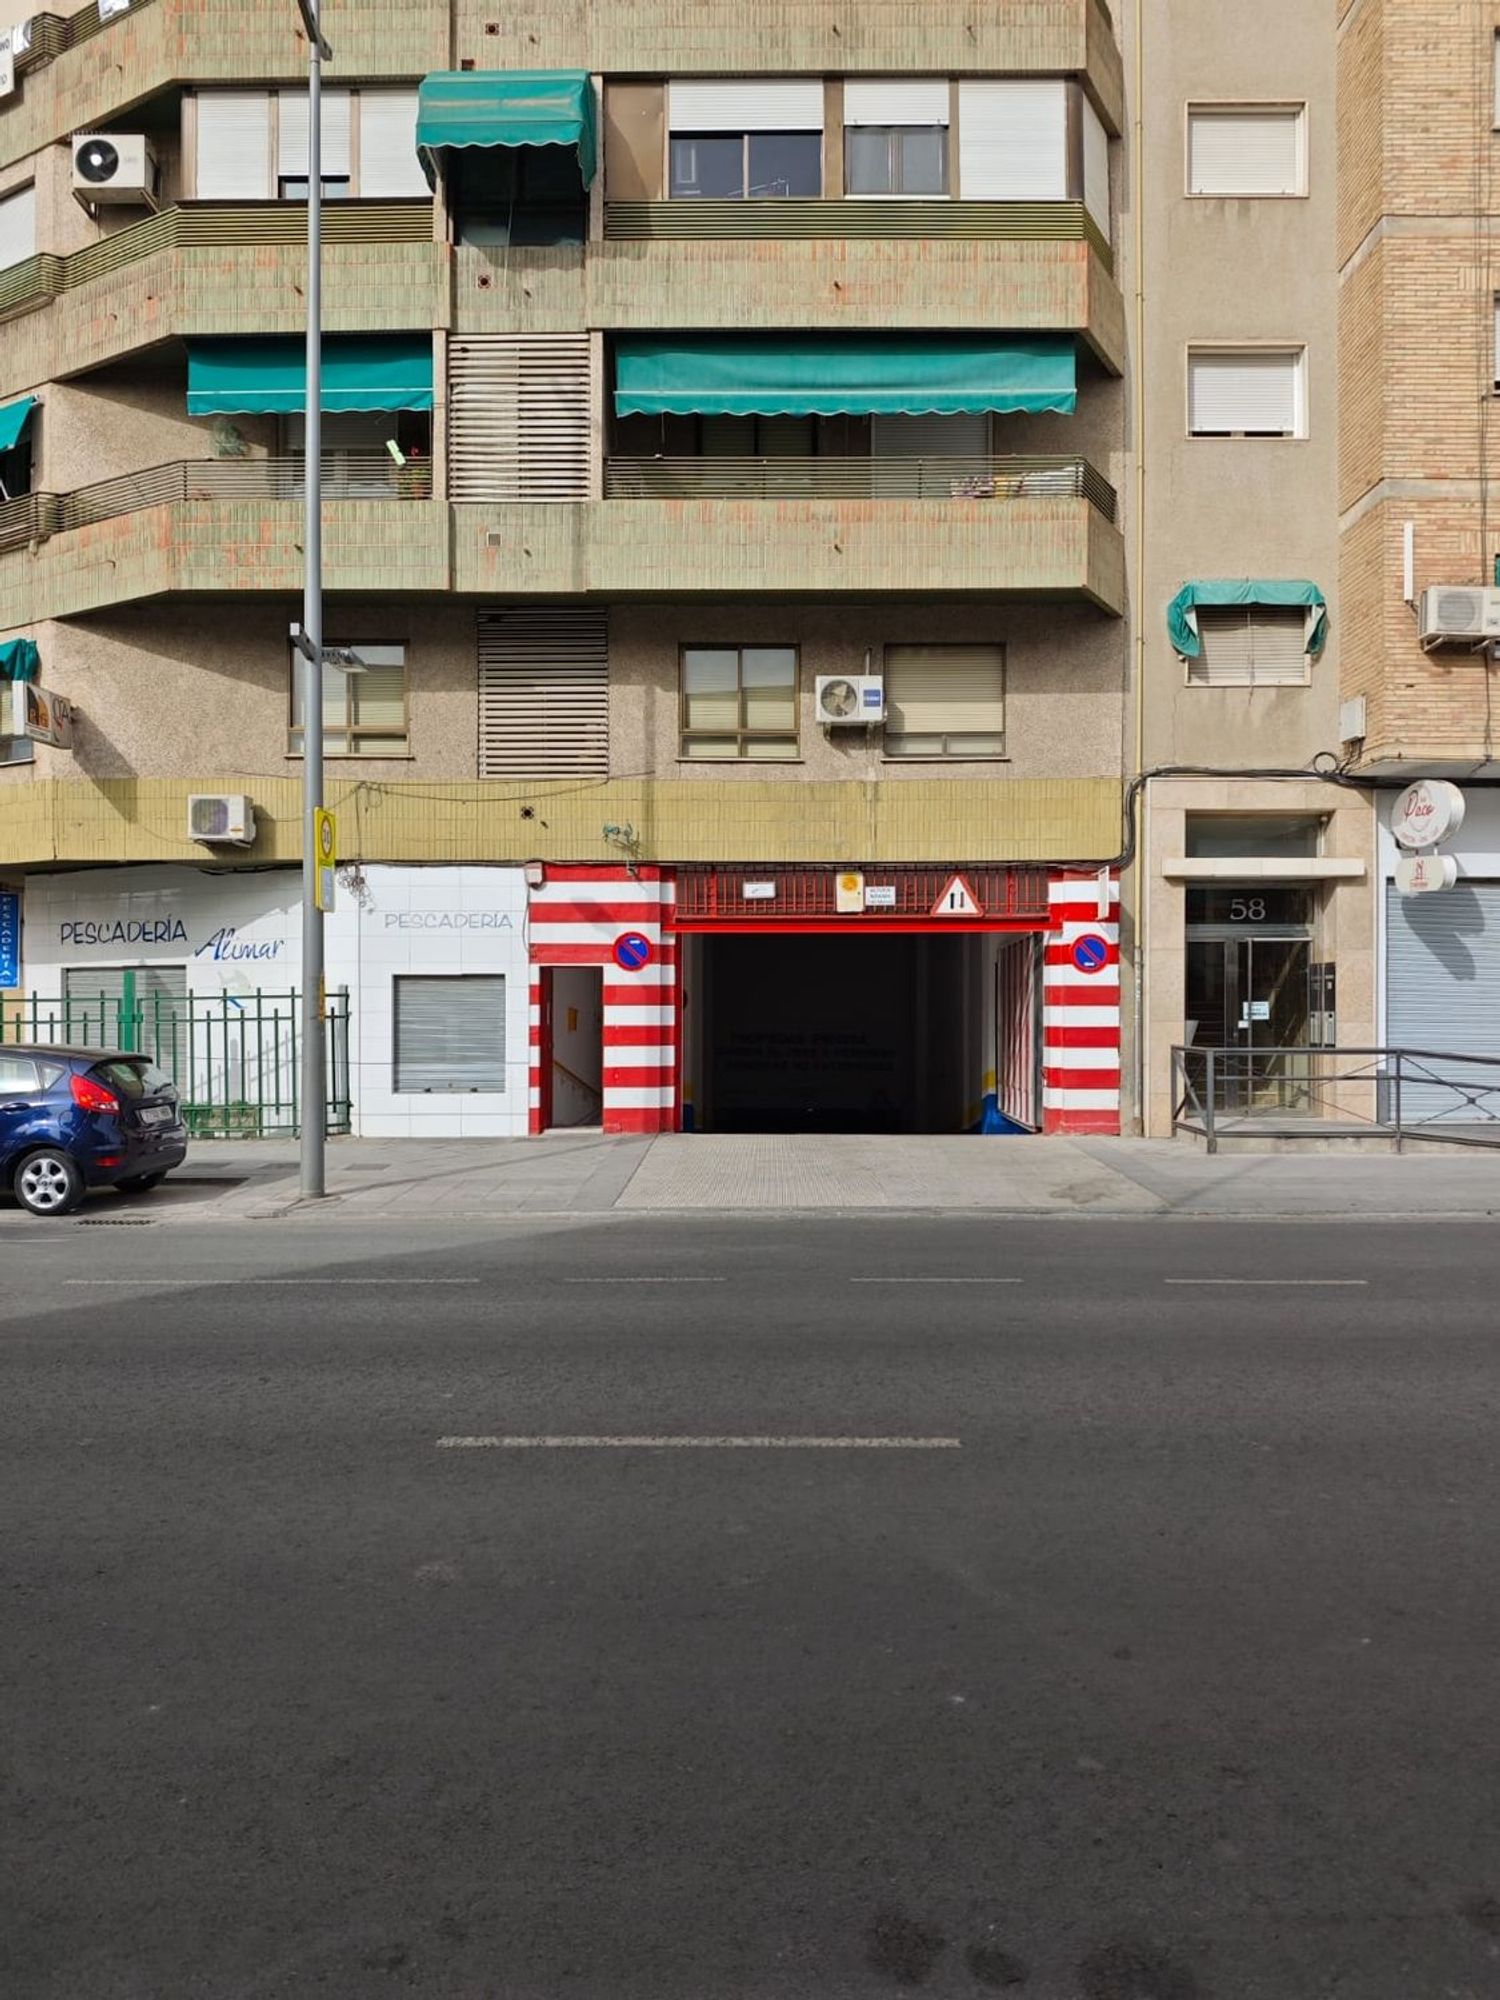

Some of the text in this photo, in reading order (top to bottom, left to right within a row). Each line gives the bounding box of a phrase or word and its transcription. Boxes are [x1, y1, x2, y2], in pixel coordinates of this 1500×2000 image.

[1230, 898, 1266, 921] 58
[60, 914, 188, 945] PESCADERÍA
[194, 927, 286, 961] Alimar
